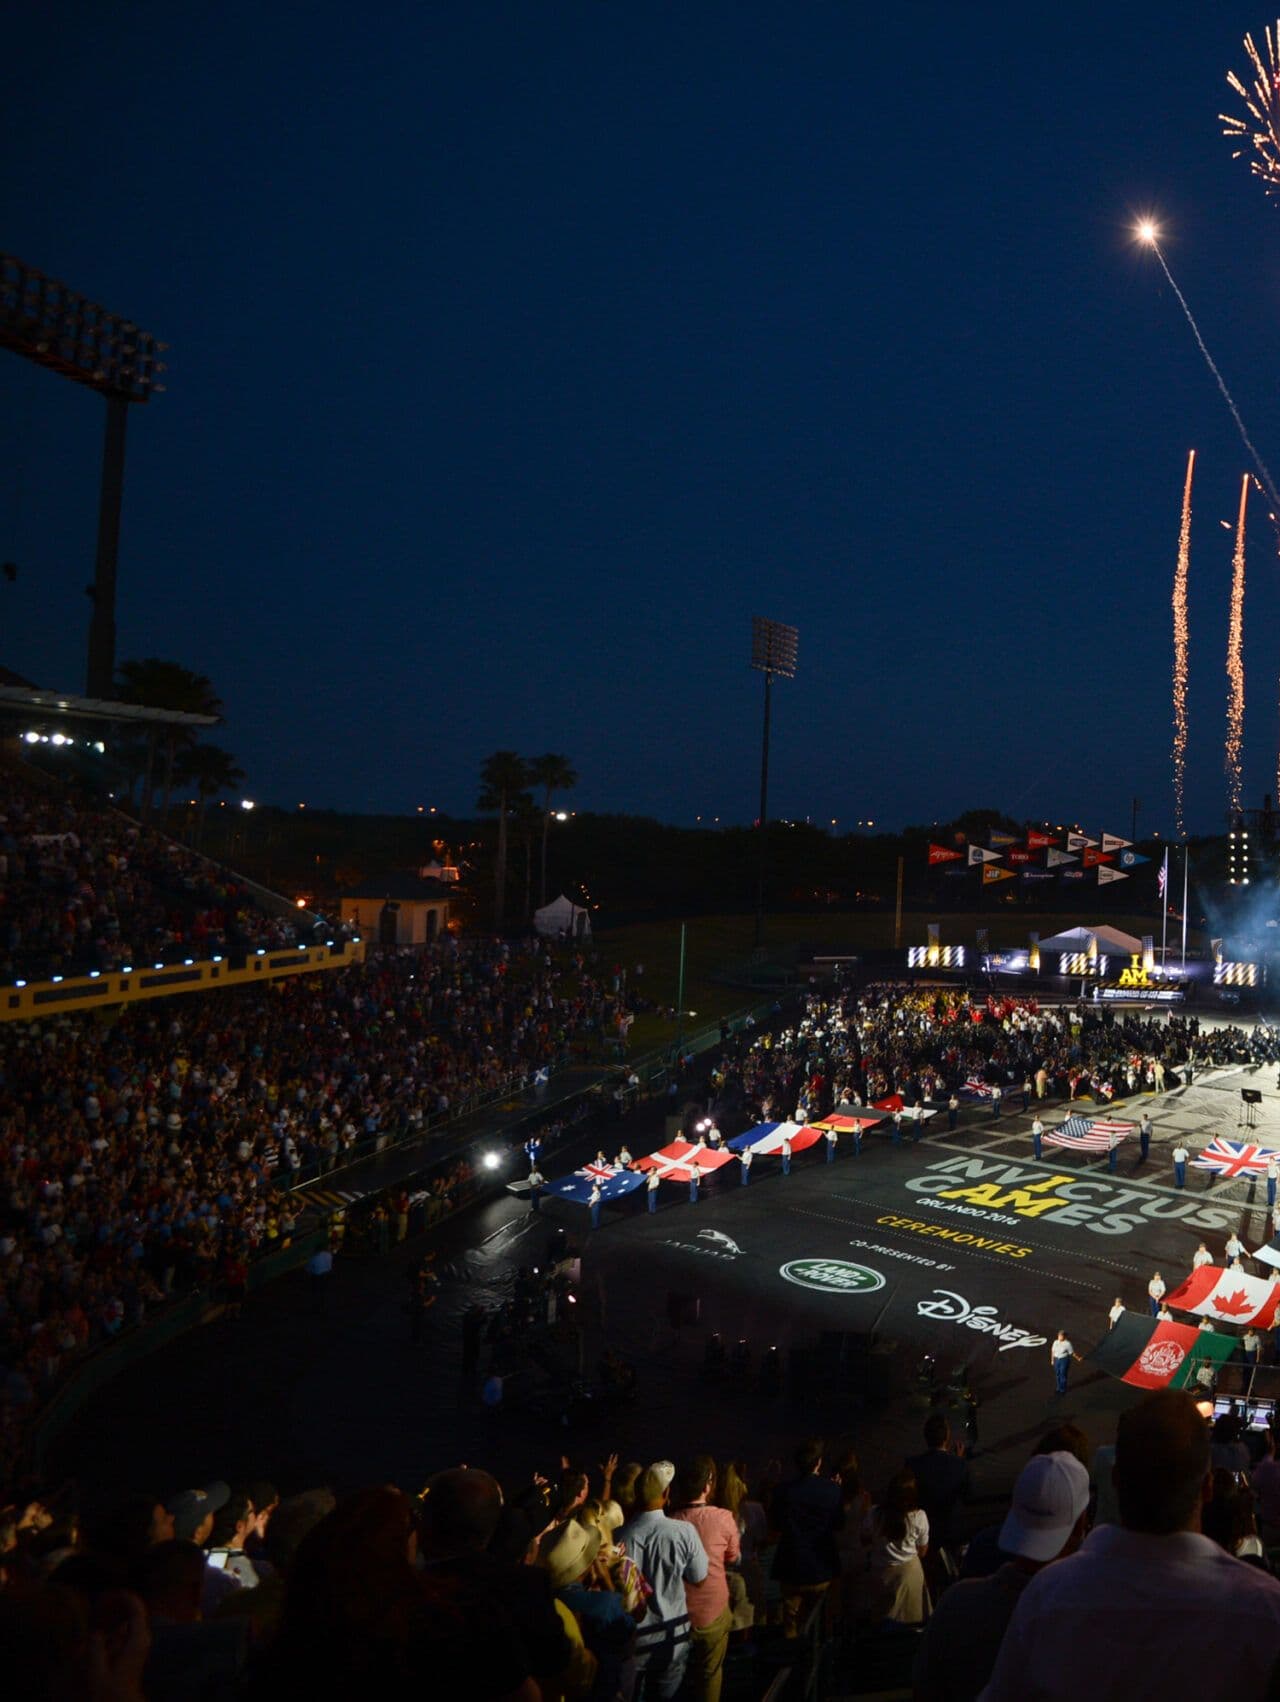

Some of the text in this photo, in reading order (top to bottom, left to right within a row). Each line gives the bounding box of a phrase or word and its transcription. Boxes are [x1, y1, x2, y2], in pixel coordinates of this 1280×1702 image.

[1119, 968, 1148, 985] AM
[904, 1174, 1149, 1236] GAMES
[925, 1156, 1240, 1230] INVICTUS
[915, 1197, 1021, 1226] ORLANDO 2016
[877, 1215, 1033, 1258] CEREMONIES
[799, 1269, 859, 1288] ROVER
[809, 1263, 862, 1280] LAND
[935, 1263, 956, 1272] BY
